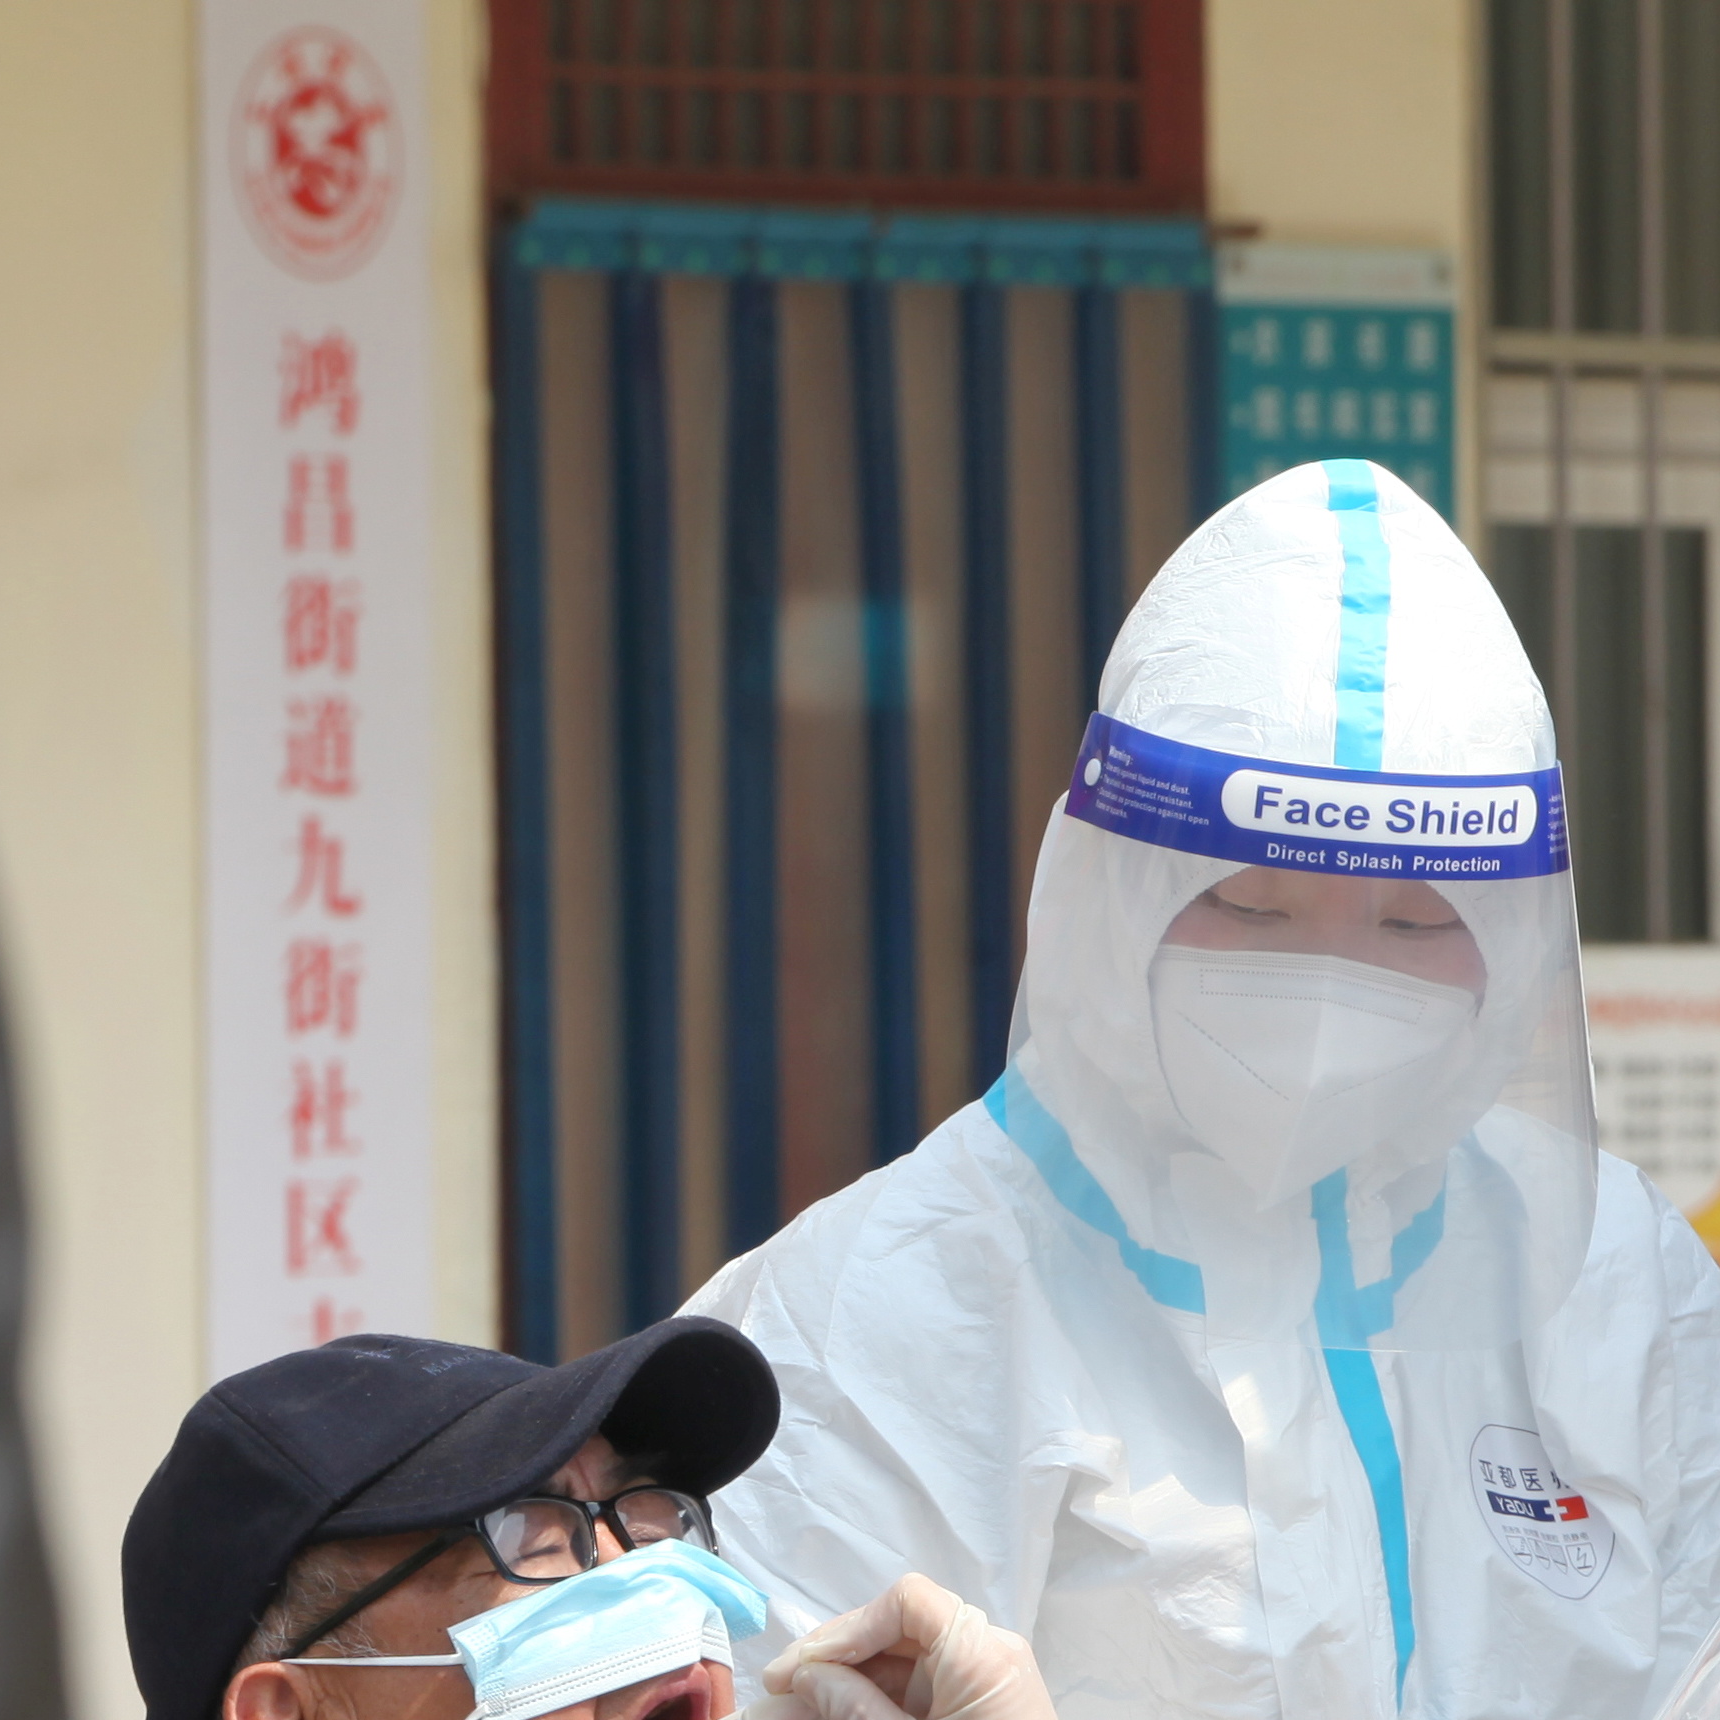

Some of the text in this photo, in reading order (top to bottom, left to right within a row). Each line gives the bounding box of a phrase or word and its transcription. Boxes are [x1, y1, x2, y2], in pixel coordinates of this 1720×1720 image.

[1187, 814, 1210, 826] open
[1254, 784, 1371, 831] Face
[1385, 798, 1519, 835] Shield
[1266, 842, 1501, 872] Direct Splash Protection
